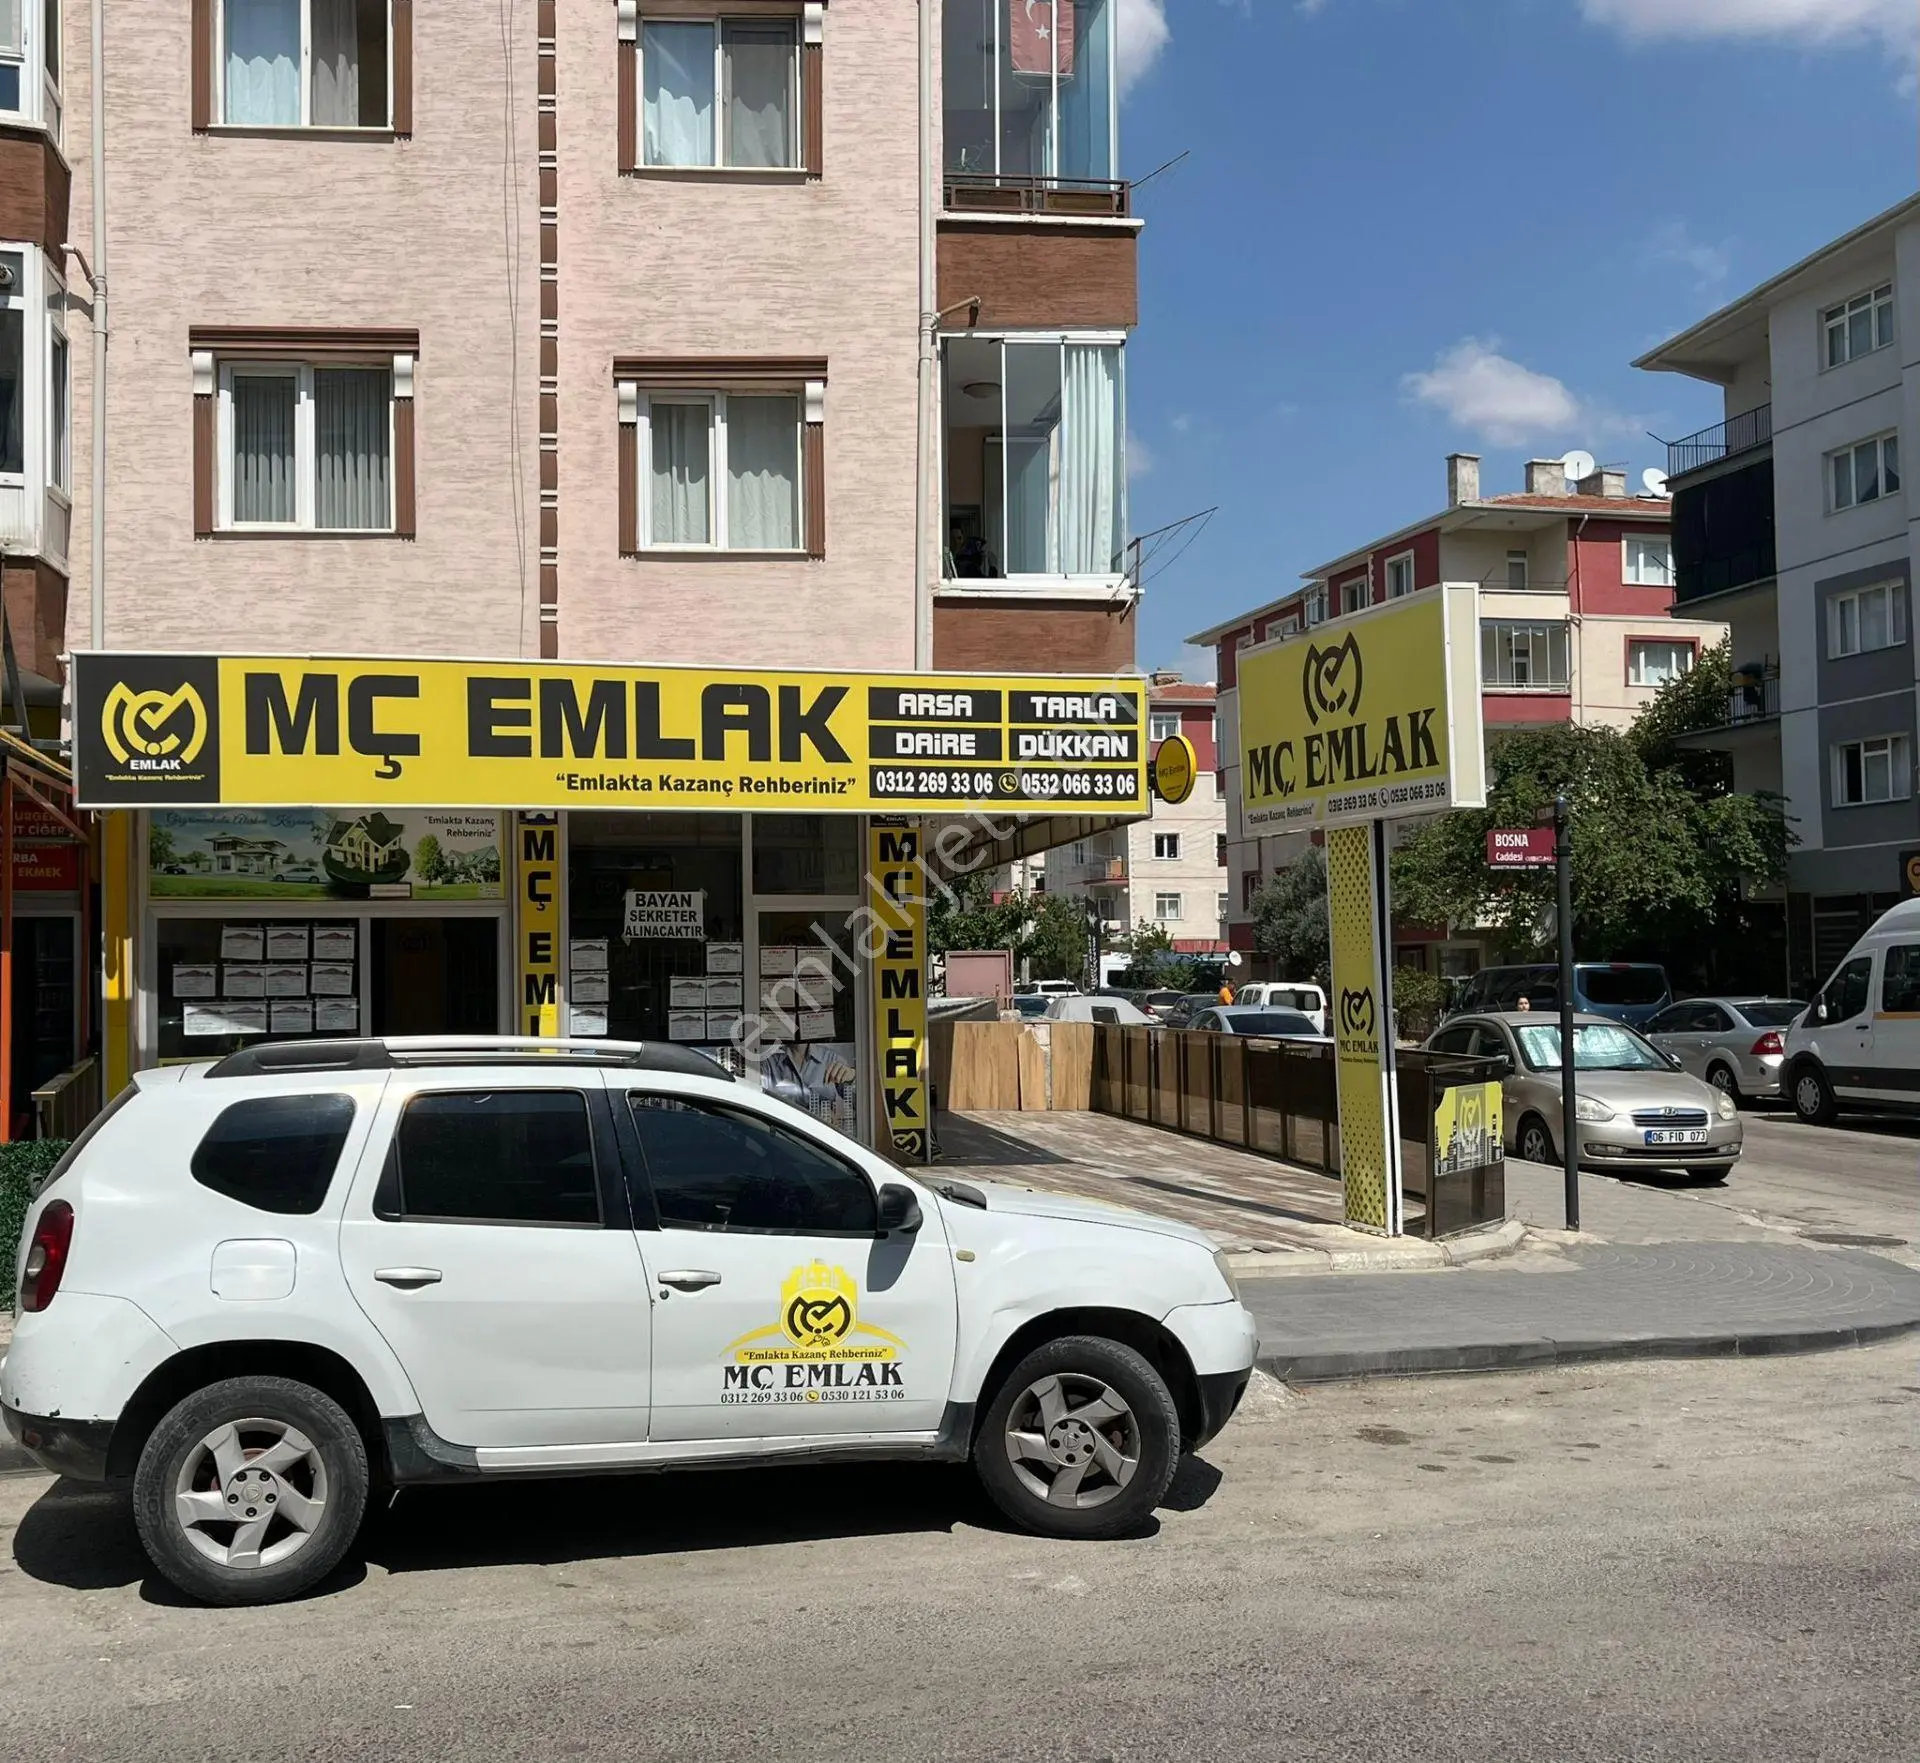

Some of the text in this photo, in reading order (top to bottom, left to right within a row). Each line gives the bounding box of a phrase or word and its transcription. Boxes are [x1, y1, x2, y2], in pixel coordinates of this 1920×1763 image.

[898, 693, 973, 717] ARSA
[1030, 696, 1117, 719] TARLA
[244, 672, 853, 780] MÇ EMLAK
[1018, 730, 1129, 758] DÜKKAN
[1247, 708, 1440, 799] MÇ EMLAK
[130, 759, 181, 770] EMLAK
[556, 773, 856, 798] “Emlakta Kazanç Rehberiniz”
[876, 770, 1135, 795] 0312 269 33 06 0532 066 33 06
[1328, 781, 1446, 812] 0312 269 33 06 0532 066 33 06
[465, 816, 495, 827] Kazanç
[1495, 833, 1529, 847] BOSNA
[1495, 852, 1523, 862] Caddesi
[635, 893, 692, 908] BAYAN
[629, 910, 698, 923] SEKRETER
[624, 925, 703, 938] ALINACAKTIR
[1652, 1131, 1705, 1142] 06 FID 073
[744, 1348, 888, 1361] “Emlakta Kazanç Rehberiniz”
[784, 1362, 904, 1388] EMLAK
[721, 1389, 905, 1404] 0312 269 33 06 0530 121 53 06
